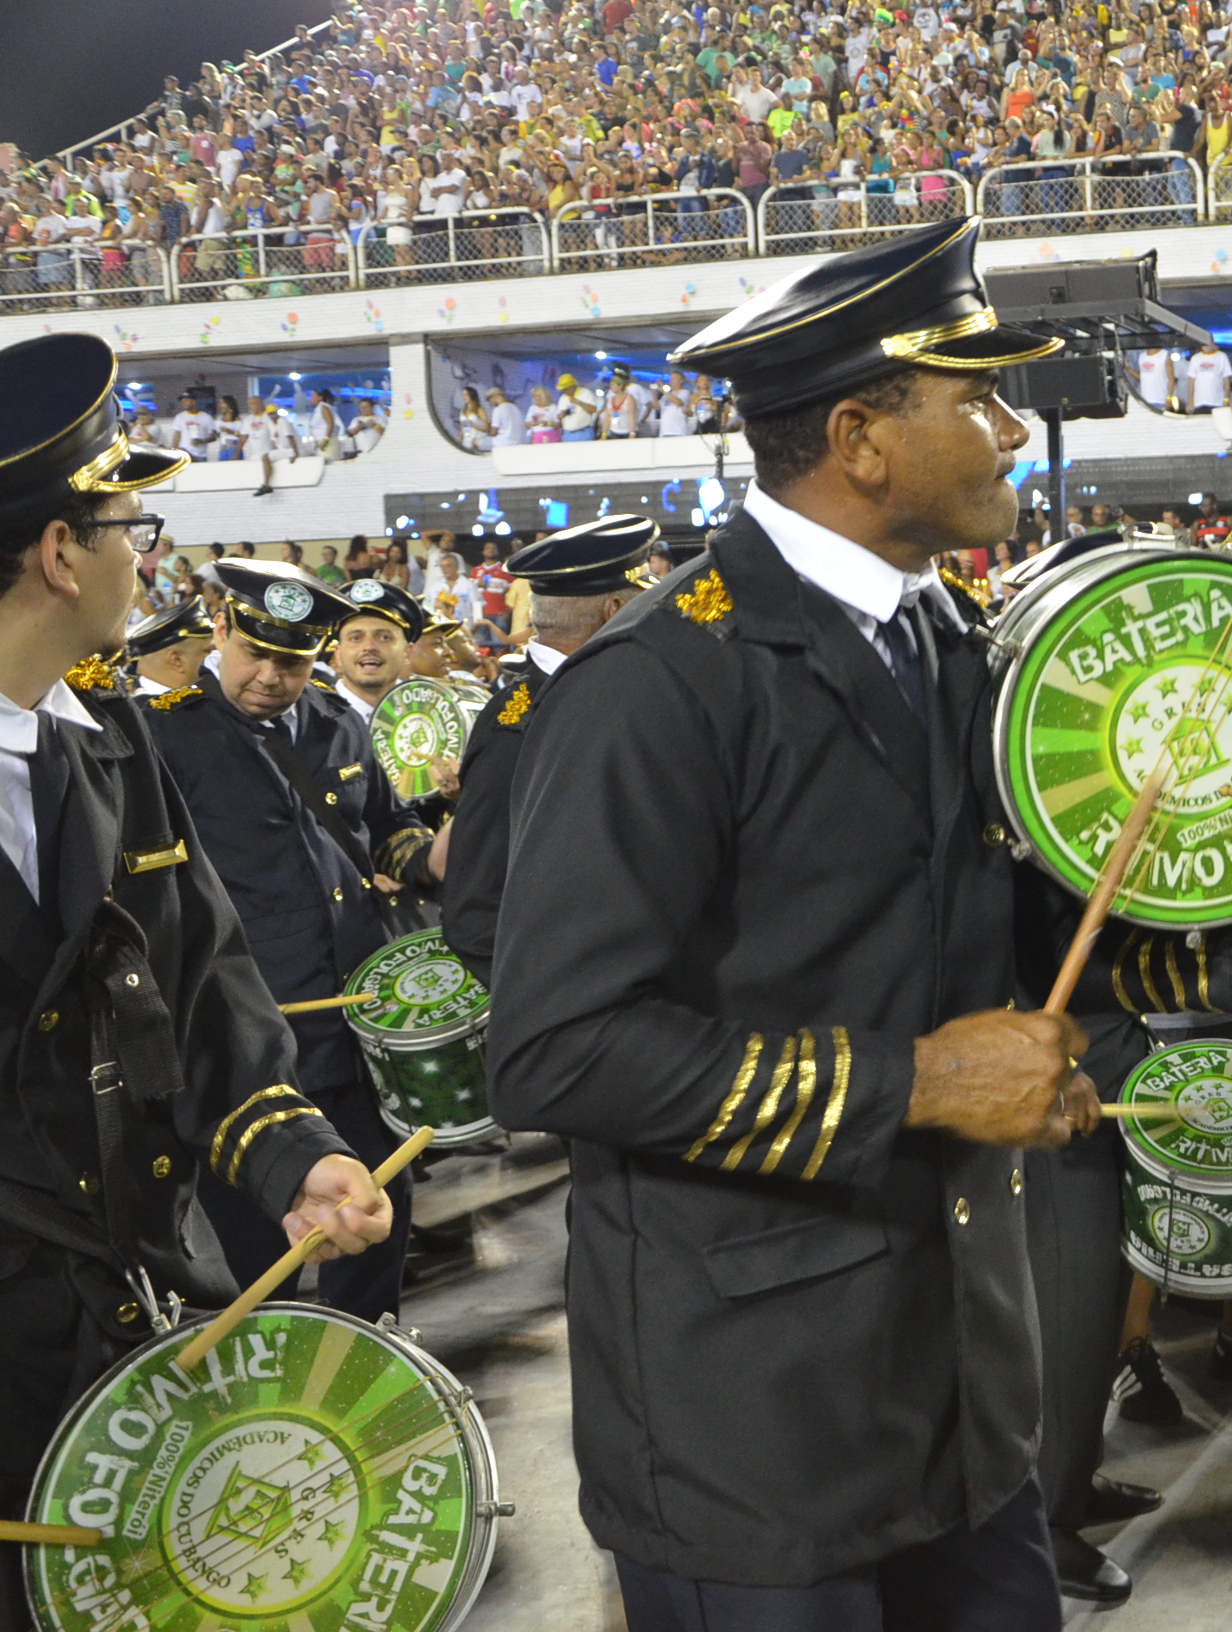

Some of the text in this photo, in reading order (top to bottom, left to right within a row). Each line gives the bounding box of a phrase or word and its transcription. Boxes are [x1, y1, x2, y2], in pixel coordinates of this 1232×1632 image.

[1179, 819, 1217, 845] 100%
[1146, 1051, 1227, 1091] BATERIA
[108, 1331, 287, 1451] RITMO
[126, 1420, 190, 1538] 100% Niterói
[176, 1429, 292, 1590] ACADÊMICOS DO CUBANGO
